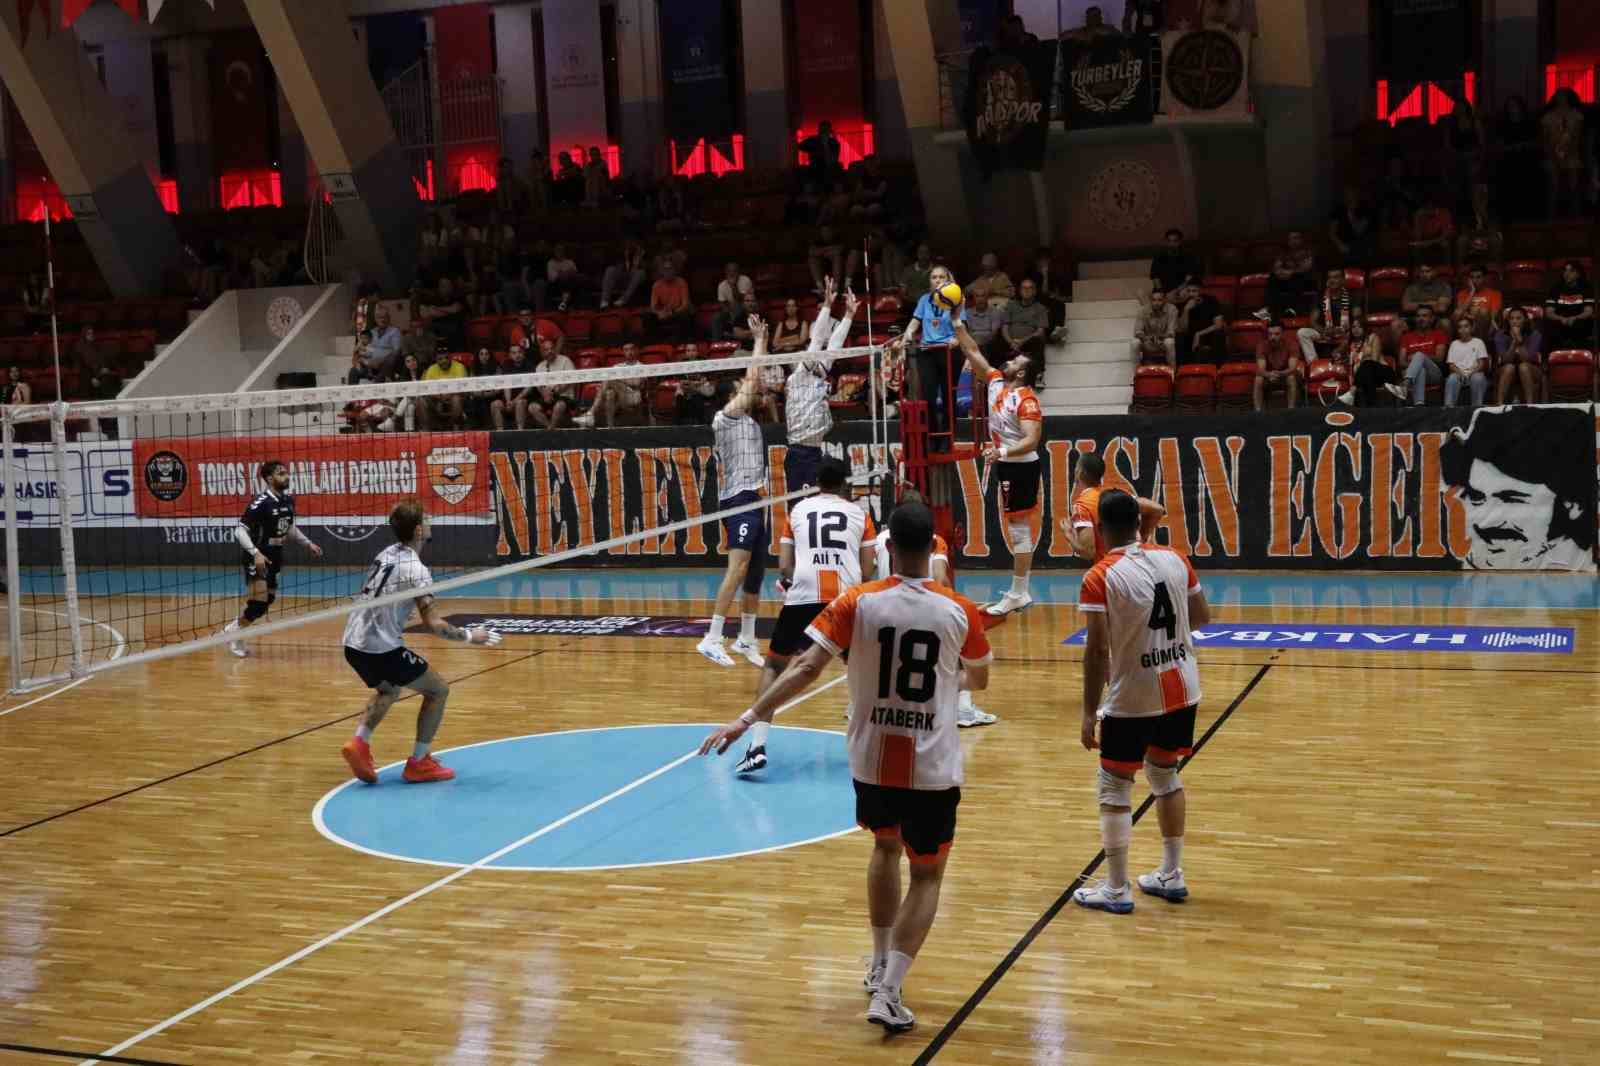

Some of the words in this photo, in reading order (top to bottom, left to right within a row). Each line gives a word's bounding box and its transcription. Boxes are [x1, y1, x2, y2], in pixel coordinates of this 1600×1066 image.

[197, 462, 247, 496] TOROS
[348, 451, 418, 494] DERNEĞİ
[1266, 411, 1472, 560] EĞER
[738, 522, 749, 537] 6
[806, 511, 848, 550] 12
[1148, 581, 1176, 641] 4
[877, 626, 941, 703] 18
[870, 706, 937, 731] ATABERK
